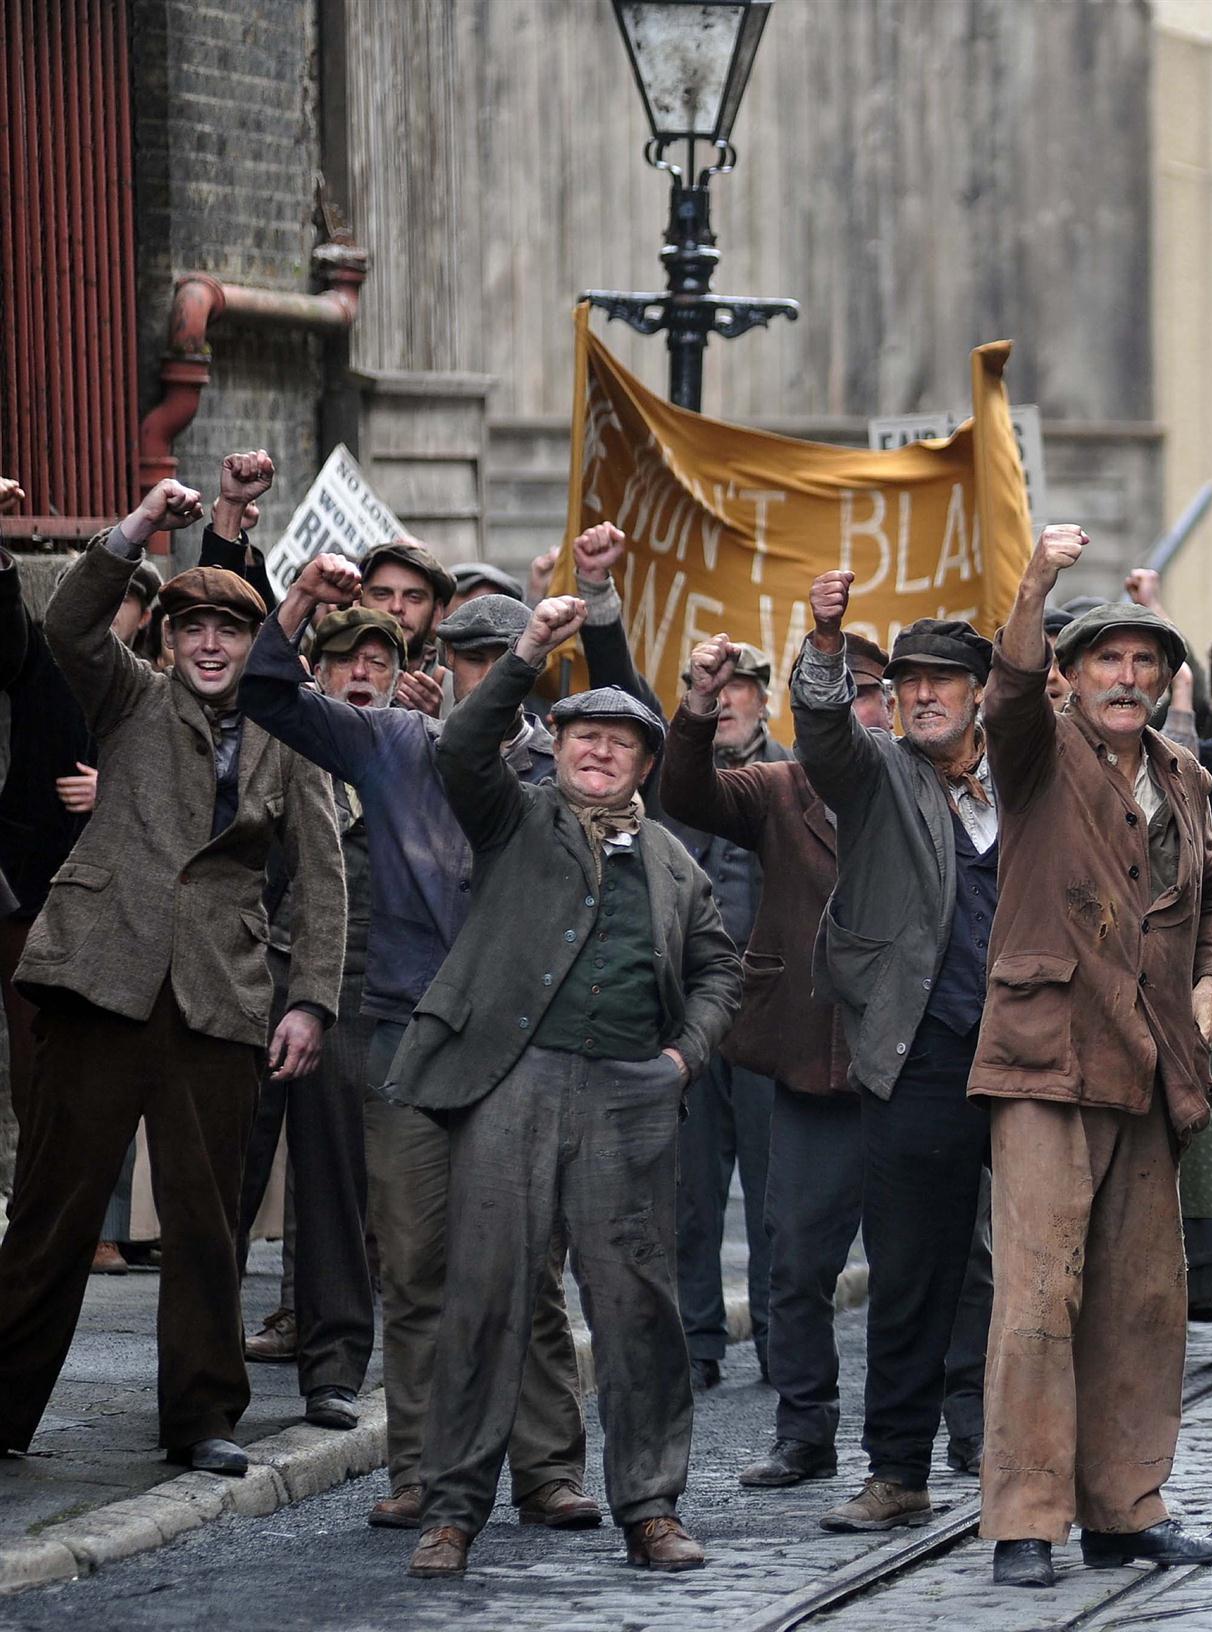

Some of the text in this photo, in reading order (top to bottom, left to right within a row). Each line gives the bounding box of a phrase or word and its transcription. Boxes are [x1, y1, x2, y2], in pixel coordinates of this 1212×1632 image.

[336, 461, 360, 492] NO
[294, 509, 346, 560] RI
[839, 482, 984, 598] BLA
